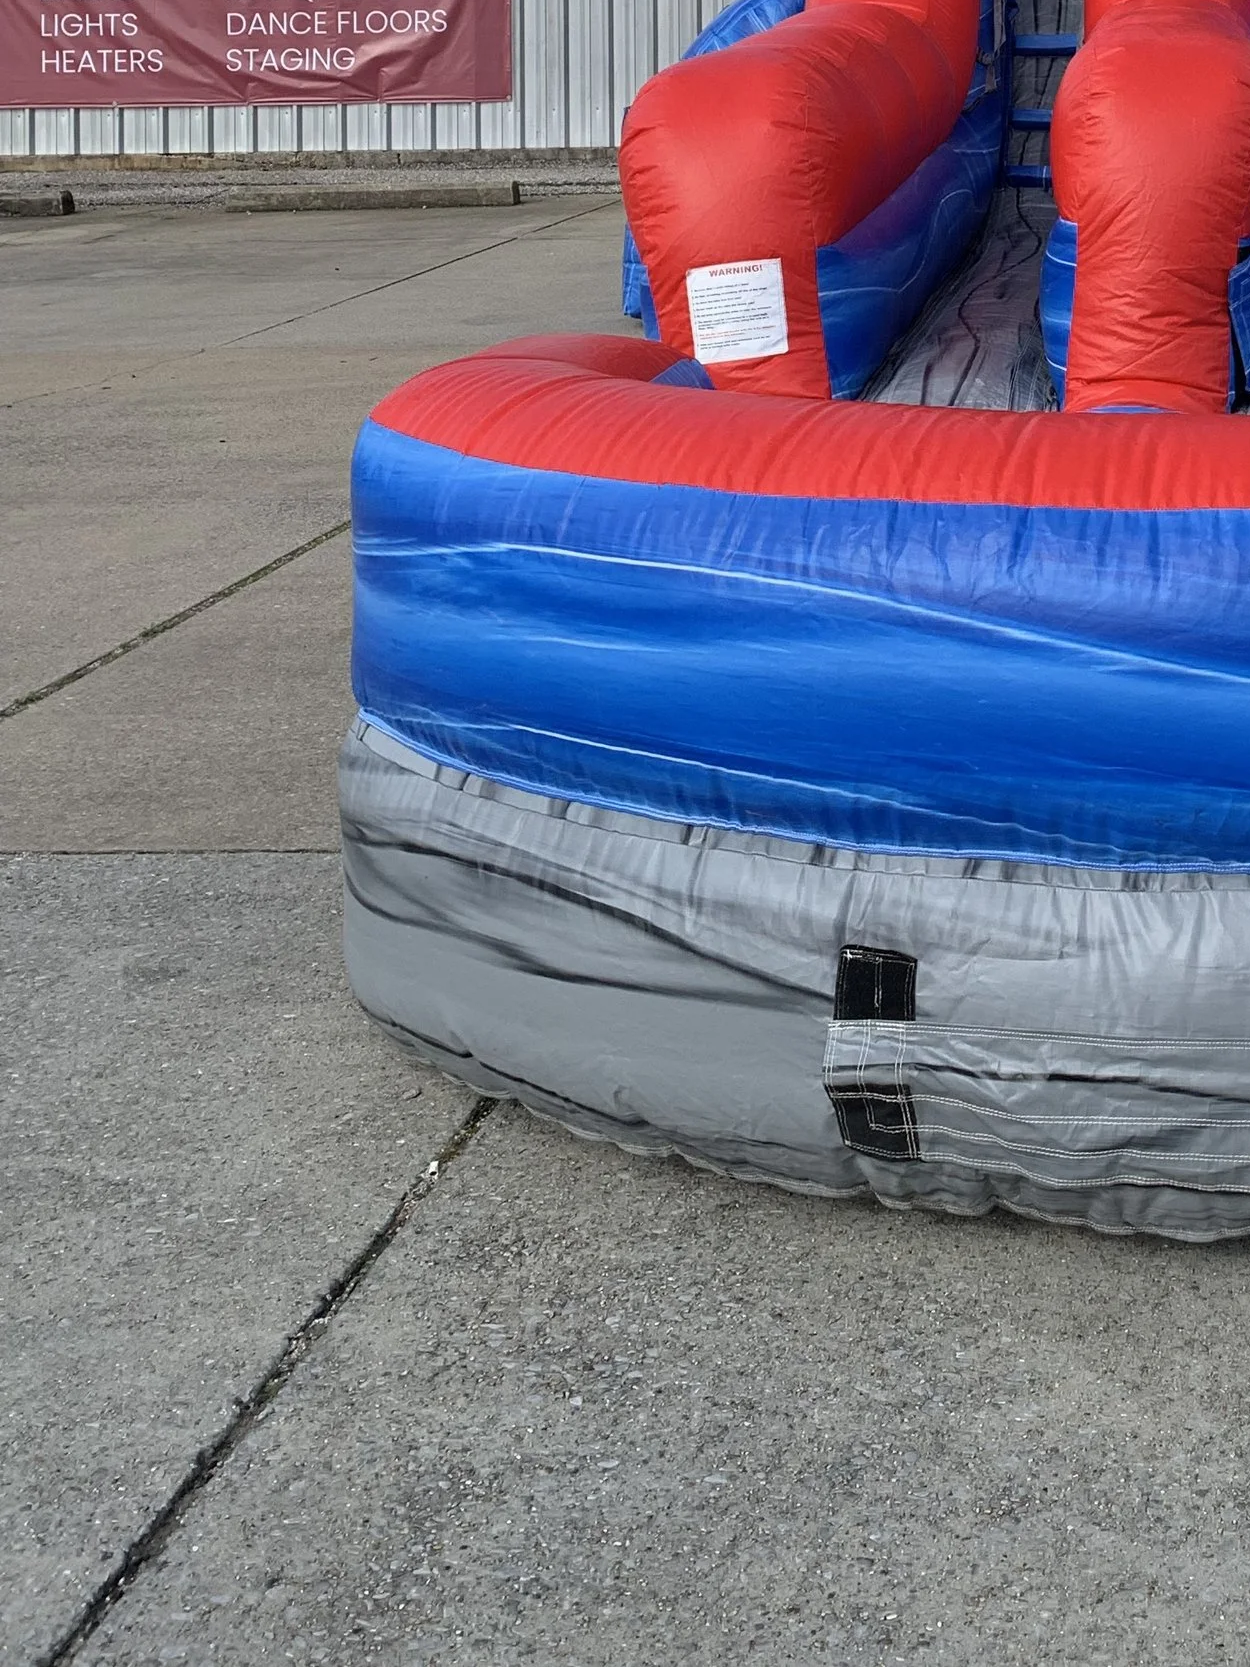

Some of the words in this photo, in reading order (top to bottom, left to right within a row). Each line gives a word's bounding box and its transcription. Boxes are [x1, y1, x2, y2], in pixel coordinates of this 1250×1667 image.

[40, 12, 139, 38] LIGHTS
[226, 10, 328, 35] DANCE
[336, 9, 448, 34] FLOORS
[40, 48, 164, 74] HEATERS
[225, 46, 357, 72] STAGING
[709, 264, 763, 277] WARNING!
